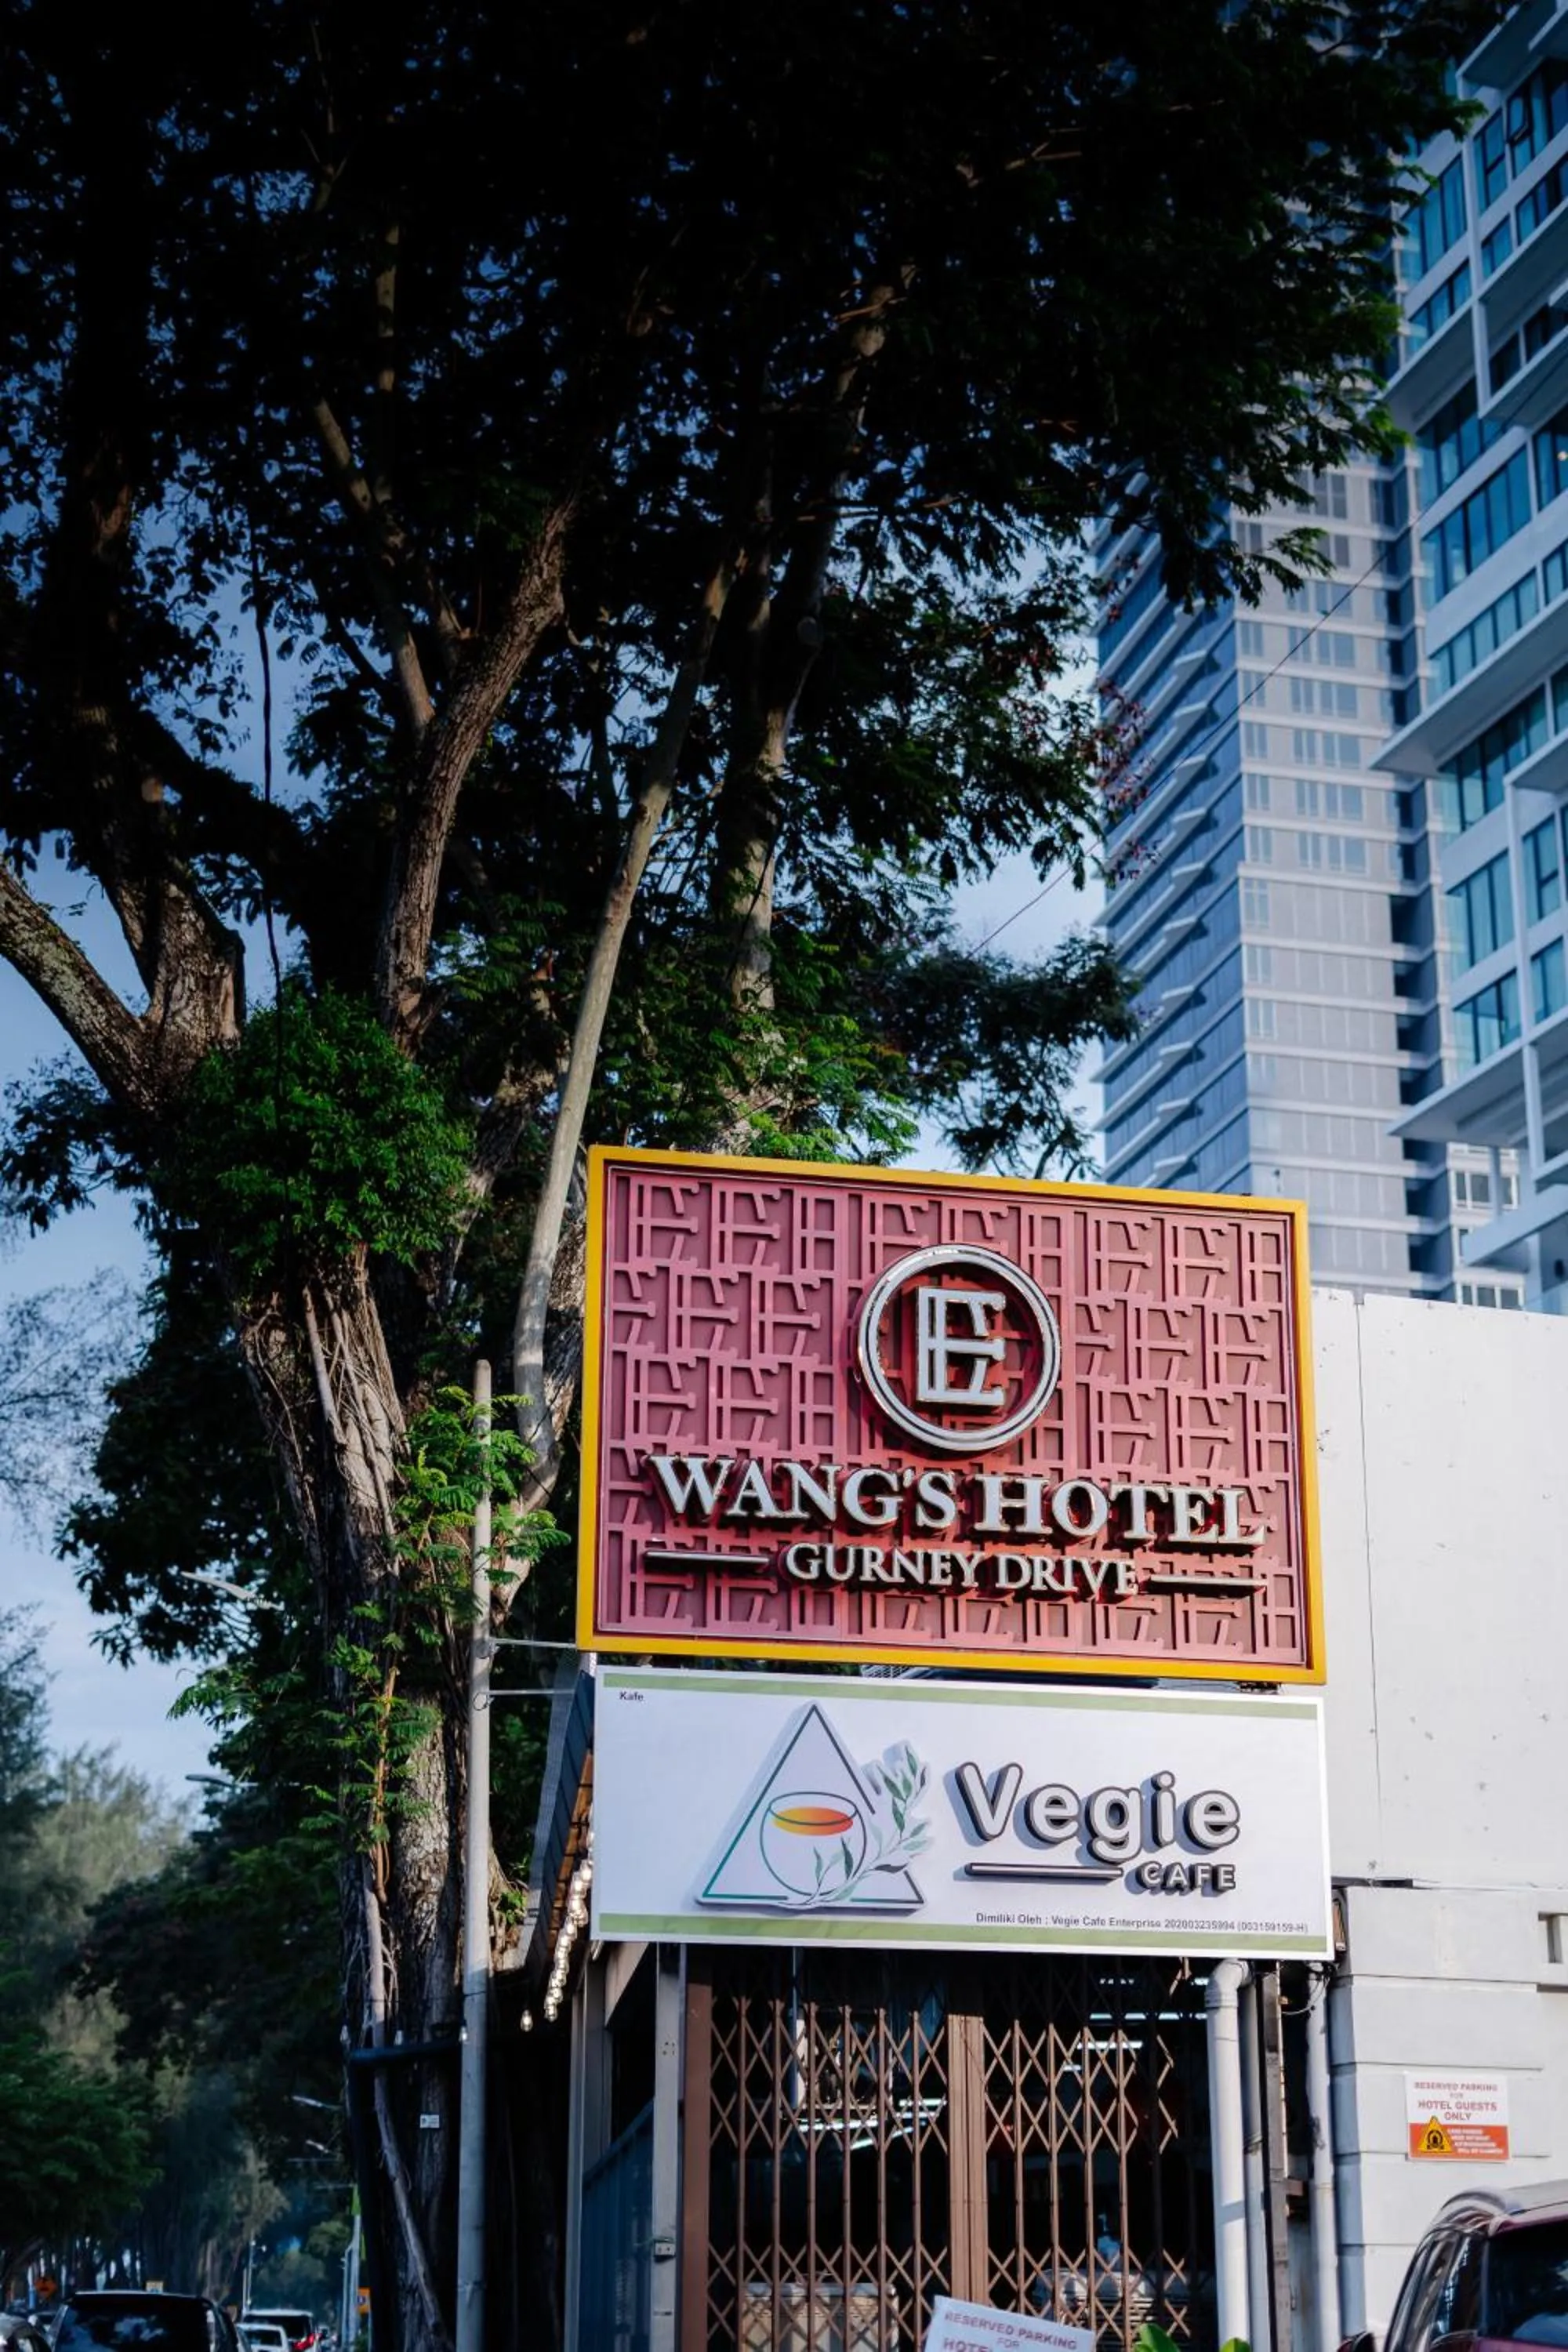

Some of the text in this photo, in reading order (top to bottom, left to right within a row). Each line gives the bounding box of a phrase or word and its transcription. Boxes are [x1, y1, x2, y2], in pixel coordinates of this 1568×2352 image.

[648, 1453, 1265, 1546] WANG'S HOTEL
[786, 1542, 1139, 1598] GURNEY DRIVE
[619, 1691, 644, 1701] Kafe
[954, 1761, 1240, 1863] Vegie
[1135, 1861, 1237, 1893] CAFE
[976, 1912, 1015, 1923] Dimiliki
[1019, 1914, 1042, 1925] Oleh
[1051, 1915, 1080, 1928] Vegie
[1083, 1916, 1105, 1926] Cafe
[1109, 1918, 1161, 1929] Enterprise
[1414, 2082, 1498, 2092] RESERVED PARKING
[1418, 2100, 1497, 2111] HOTEL GUESTS
[1443, 2112, 1472, 2121] ONLY
[944, 2312, 1077, 2350] RESERVED PARKING
[996, 2337, 1019, 2349] FOR
